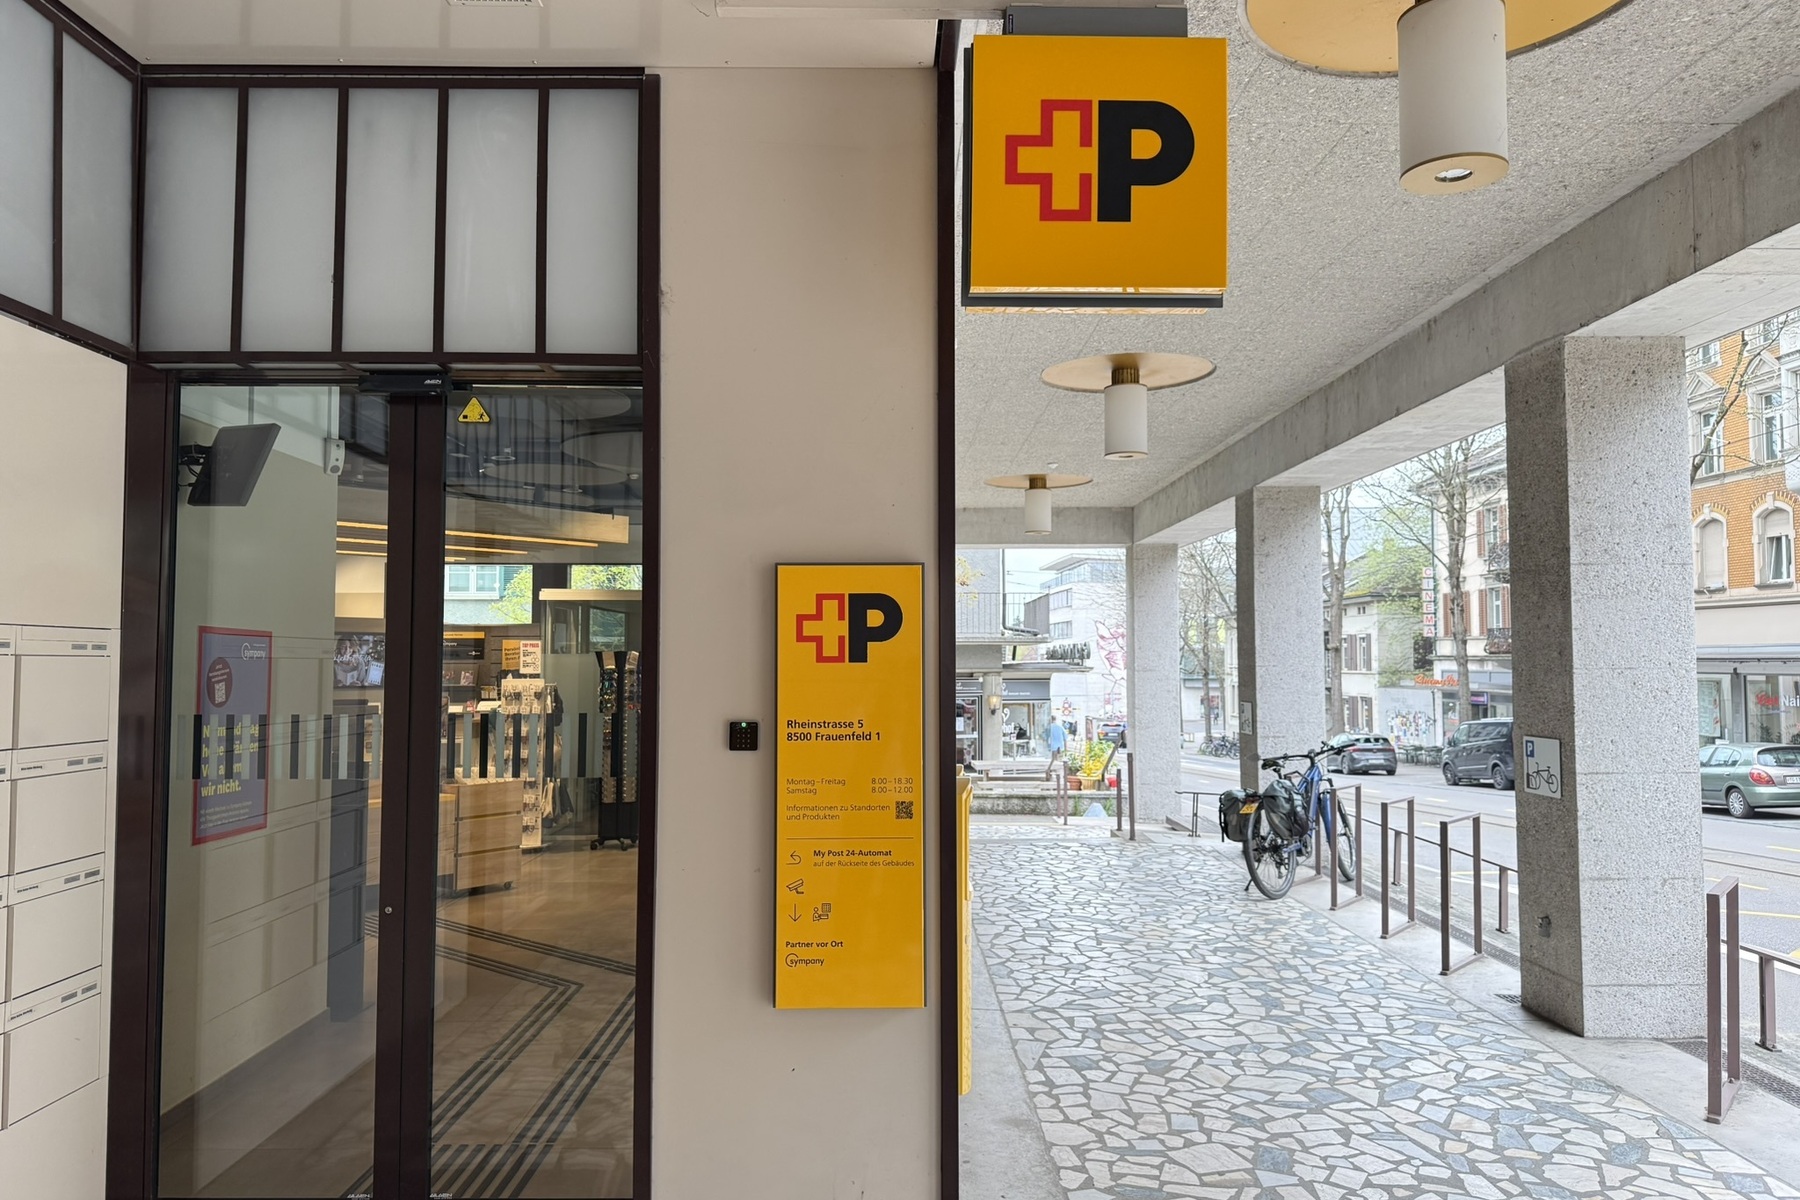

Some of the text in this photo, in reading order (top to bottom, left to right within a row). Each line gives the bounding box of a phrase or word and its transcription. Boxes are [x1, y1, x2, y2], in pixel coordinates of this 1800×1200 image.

[1097, 100, 1195, 222] P
[1423, 567, 1434, 636] CINEMA
[848, 593, 903, 663] P
[787, 719, 864, 729] Rheinstrasse 5
[786, 731, 881, 741] 8500 Frauenfeld 1
[201, 779, 242, 797] wir nicht.
[786, 787, 817, 795] Samstag
[786, 804, 838, 812] Informationen
[813, 849, 892, 858] My Post 24-Automat
[830, 940, 844, 948] Ort
[785, 953, 825, 967] sympany
